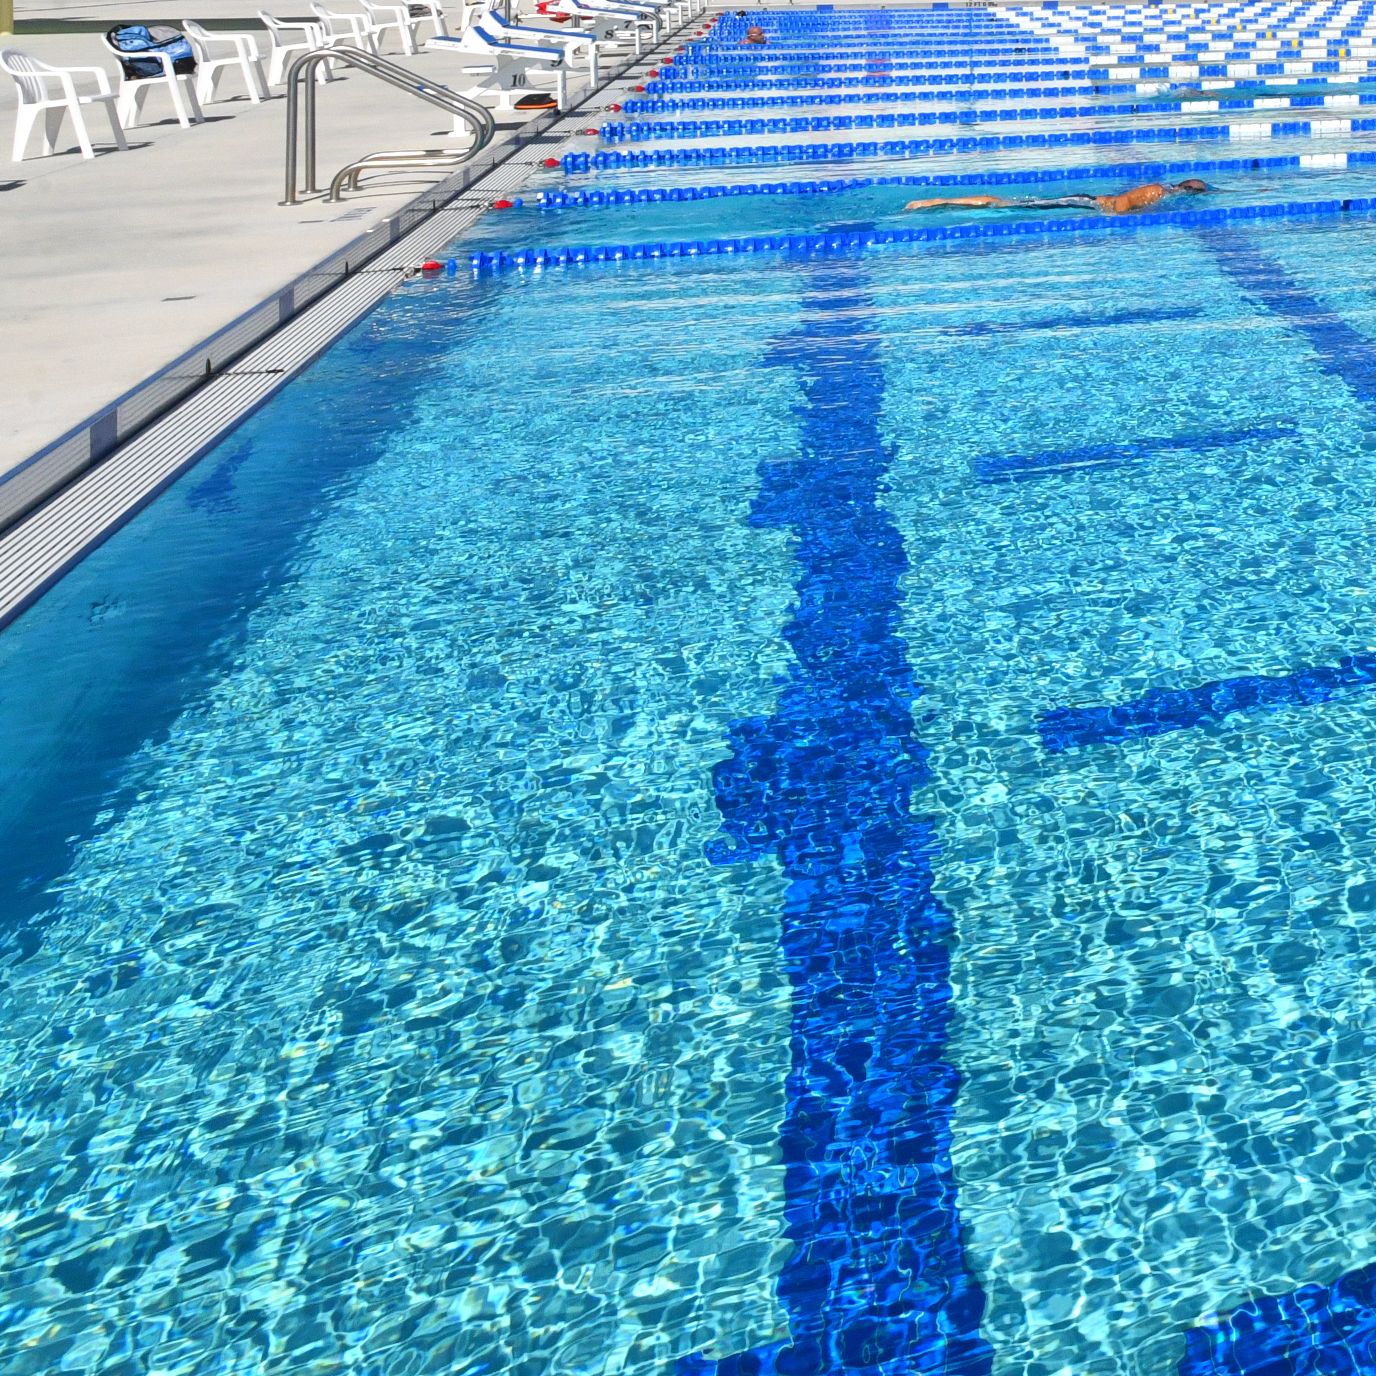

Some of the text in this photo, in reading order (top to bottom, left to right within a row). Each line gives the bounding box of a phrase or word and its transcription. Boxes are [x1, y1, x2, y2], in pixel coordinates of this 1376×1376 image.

[624, 20, 632, 29] 7
[604, 30, 615, 39] 8
[510, 74, 526, 88] 10
